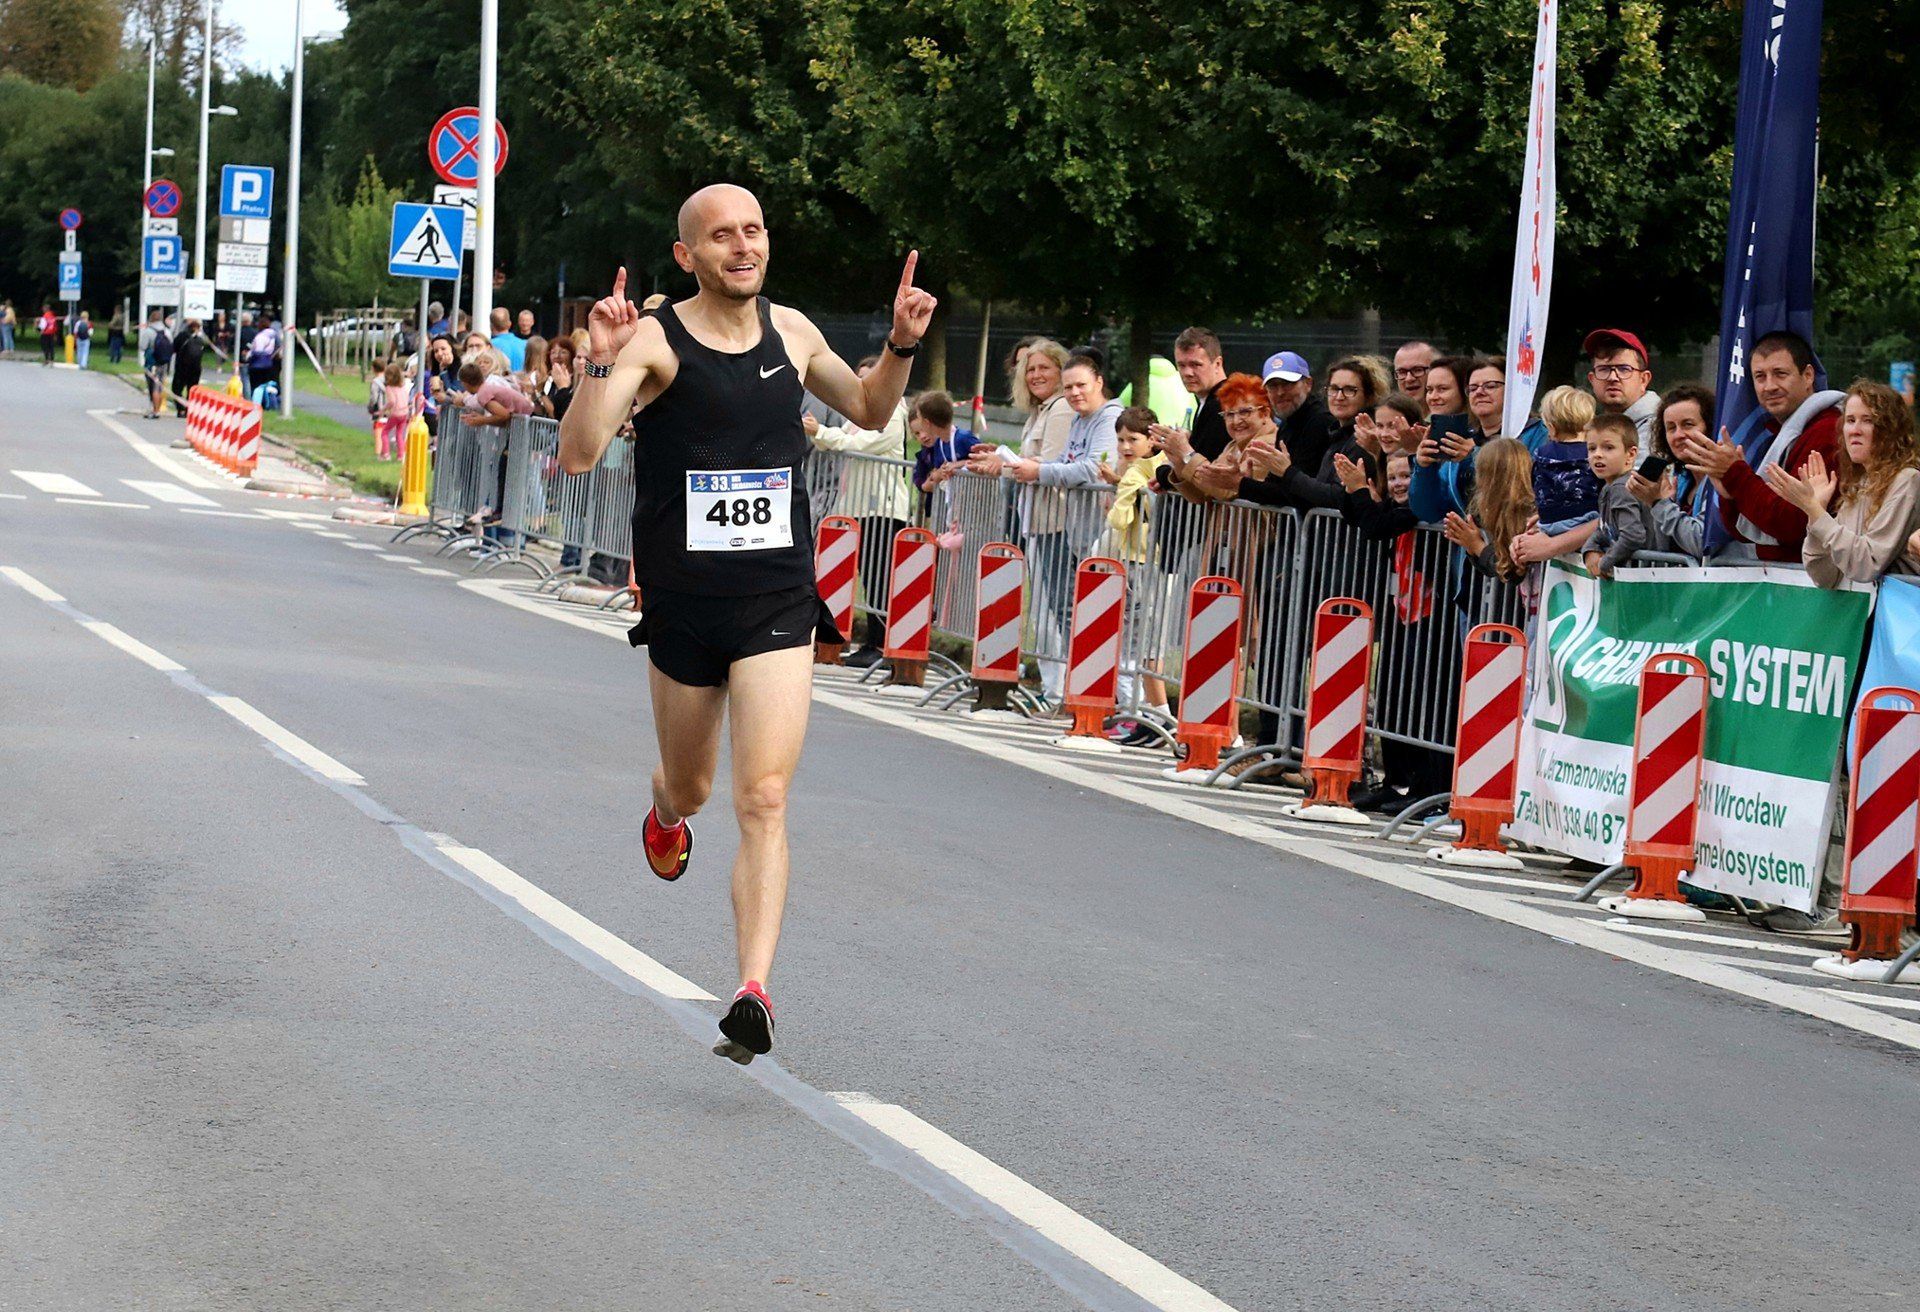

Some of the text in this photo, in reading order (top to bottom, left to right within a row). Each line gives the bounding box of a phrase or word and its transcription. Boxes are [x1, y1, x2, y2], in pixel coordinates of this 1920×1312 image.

[231, 171, 263, 211] P
[64, 264, 78, 282] P
[152, 240, 174, 270] P
[706, 497, 772, 527] 488
[1709, 638, 1846, 718] SYSTEM
[1563, 805, 1581, 838] 338
[1584, 810, 1598, 842] 40
[1602, 813, 1625, 844] 87
[1714, 783, 1788, 828] Wrocław
